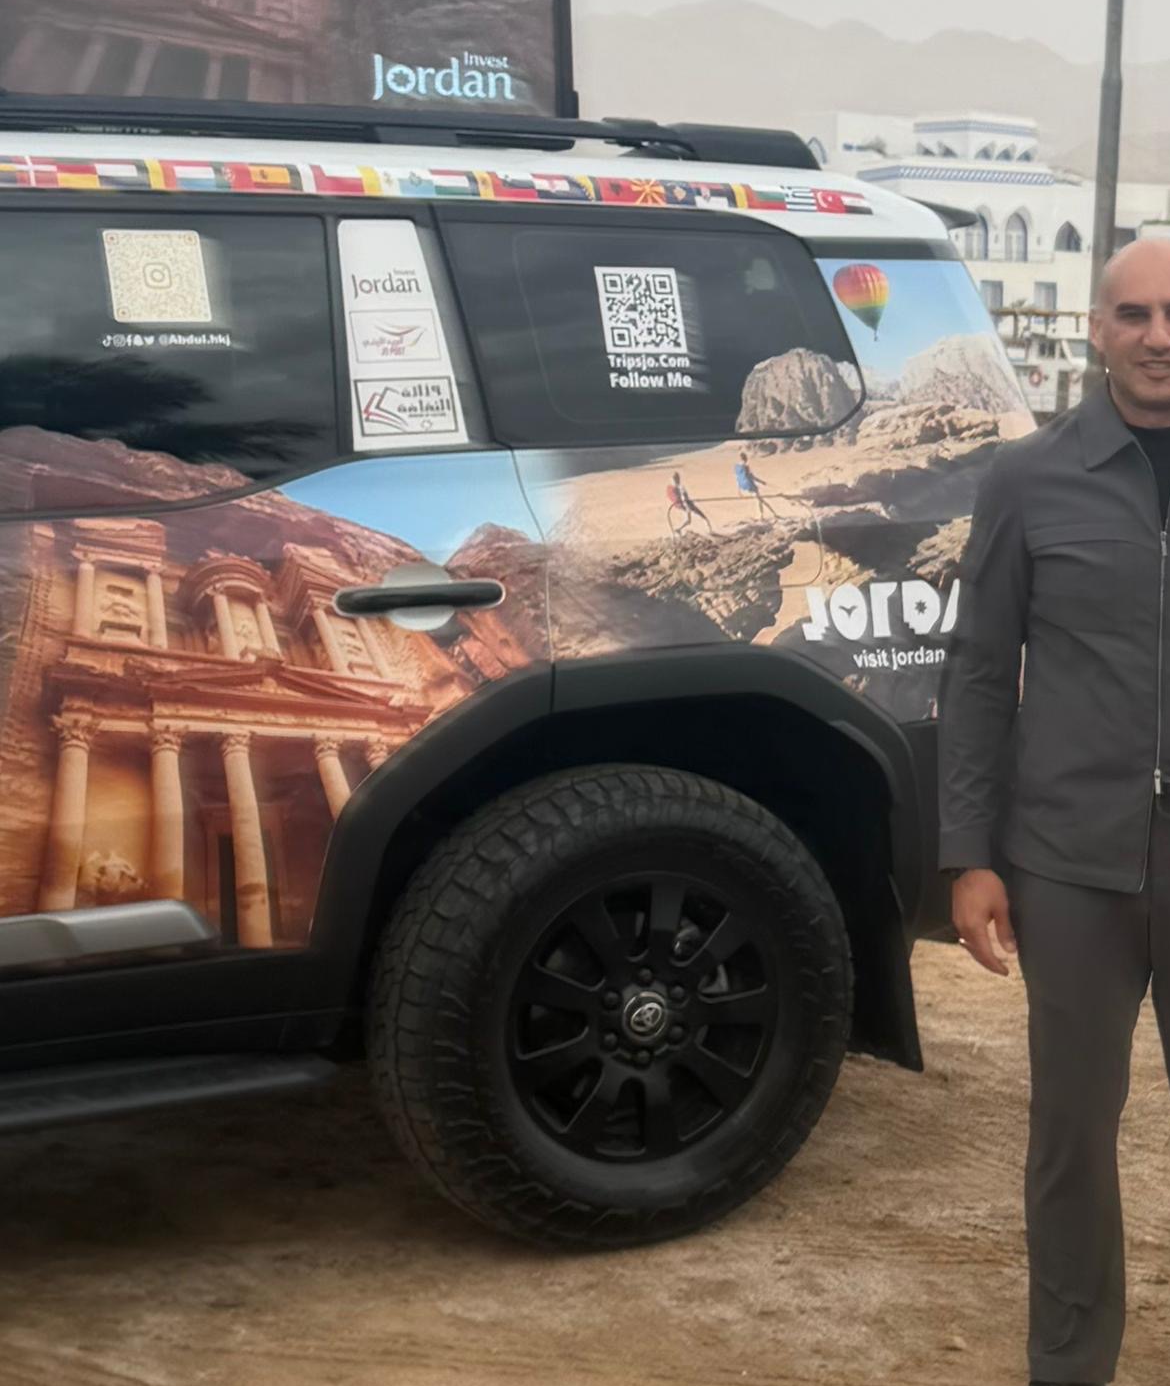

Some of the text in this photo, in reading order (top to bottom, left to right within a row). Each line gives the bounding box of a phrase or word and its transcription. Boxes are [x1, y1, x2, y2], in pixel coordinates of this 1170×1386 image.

[463, 51, 509, 68] Invest
[372, 53, 516, 100] Jordan
[351, 272, 421, 300] Jordan
[607, 354, 690, 371] Tripsjo.Com
[609, 371, 693, 388] Follow Me
[853, 645, 946, 671] visit jordan
